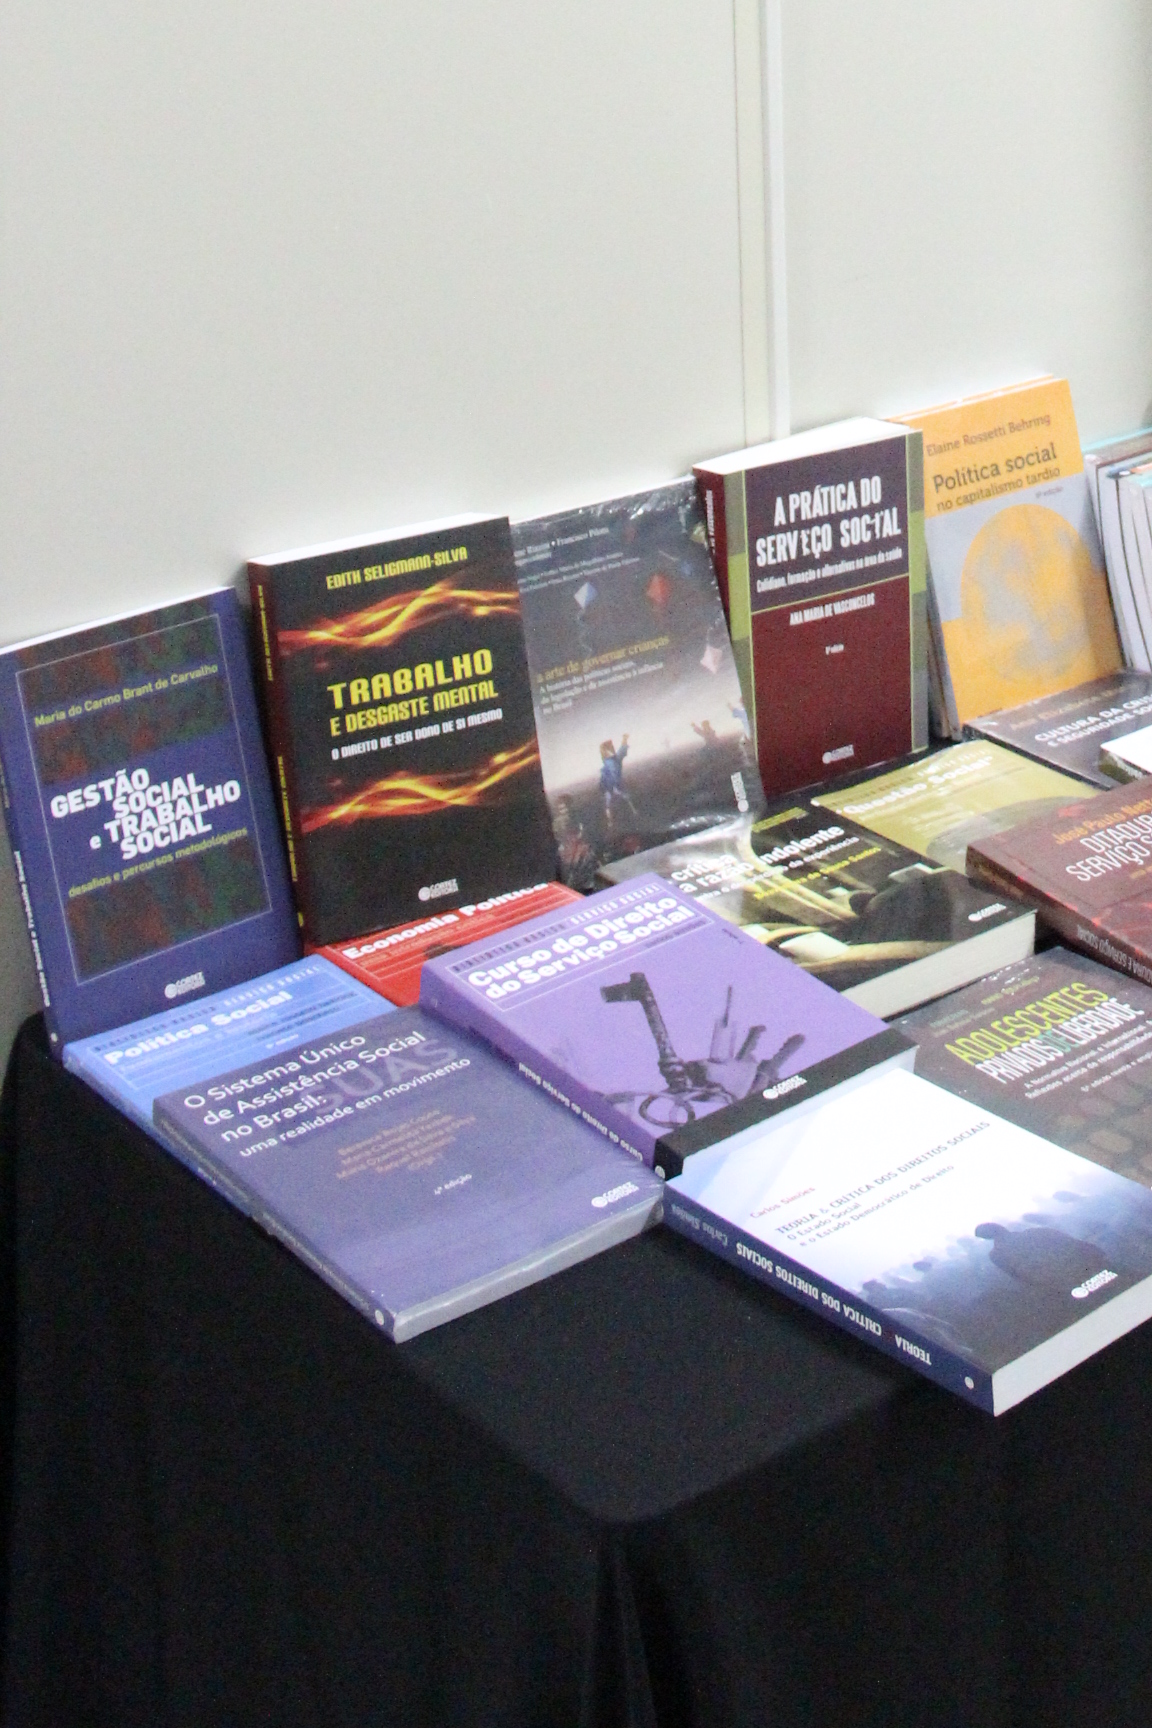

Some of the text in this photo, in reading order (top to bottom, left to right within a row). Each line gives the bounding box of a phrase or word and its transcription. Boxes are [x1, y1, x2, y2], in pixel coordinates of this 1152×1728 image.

[926, 414, 1051, 456] Elaine Rossetti Behring
[933, 442, 1057, 493] Política social
[937, 500, 953, 512] no
[956, 478, 1023, 505] capitalismo
[774, 475, 882, 527] A PRÁTICA DO
[326, 546, 468, 590] EDITH SELIGMANN-SILVA
[789, 592, 875, 626] ANA MARIA DE VASCONCELOS
[34, 664, 219, 727] Maria do Carmo Brant de Carvalho
[327, 648, 493, 710] TRABALHO
[330, 680, 498, 737] E DESGASTE MENTAL
[331, 707, 503, 761] O DIREITO DE SER DONO DE SI MESMO
[50, 768, 150, 818] GESTÃO
[89, 780, 241, 850] e TRABALHO
[112, 772, 204, 820] SOCIAL
[68, 827, 248, 898] desafios e percursos metodológicos
[120, 812, 213, 860] SOCIAL
[1065, 840, 1151, 882] SERVIÇO
[468, 895, 678, 989] Curso de Direito
[485, 905, 697, 1000] do Serviço Social
[104, 1023, 209, 1066] Política
[210, 990, 293, 1026] Social
[945, 982, 1109, 1067] ADOLESCENTES
[974, 1038, 1065, 1084] PRIVADOS
[1058, 997, 1146, 1046] LIBERDADE
[184, 1035, 366, 1109] O Sistema Único
[203, 1030, 427, 1126] de Assistência Social
[220, 1094, 327, 1143] no Brasil:
[240, 1057, 471, 1158] uma realidade em movimento
[774, 1212, 819, 1236] TEORIA
[829, 1183, 876, 1210] CRÍTICA
[874, 1171, 899, 1186] DOS
[897, 1144, 948, 1174] DIREITOS
[946, 1121, 991, 1147] SOCIAIS
[736, 1241, 932, 1366] TEORIA CRÍTICA DOS DIREITOS SOCIAIS
